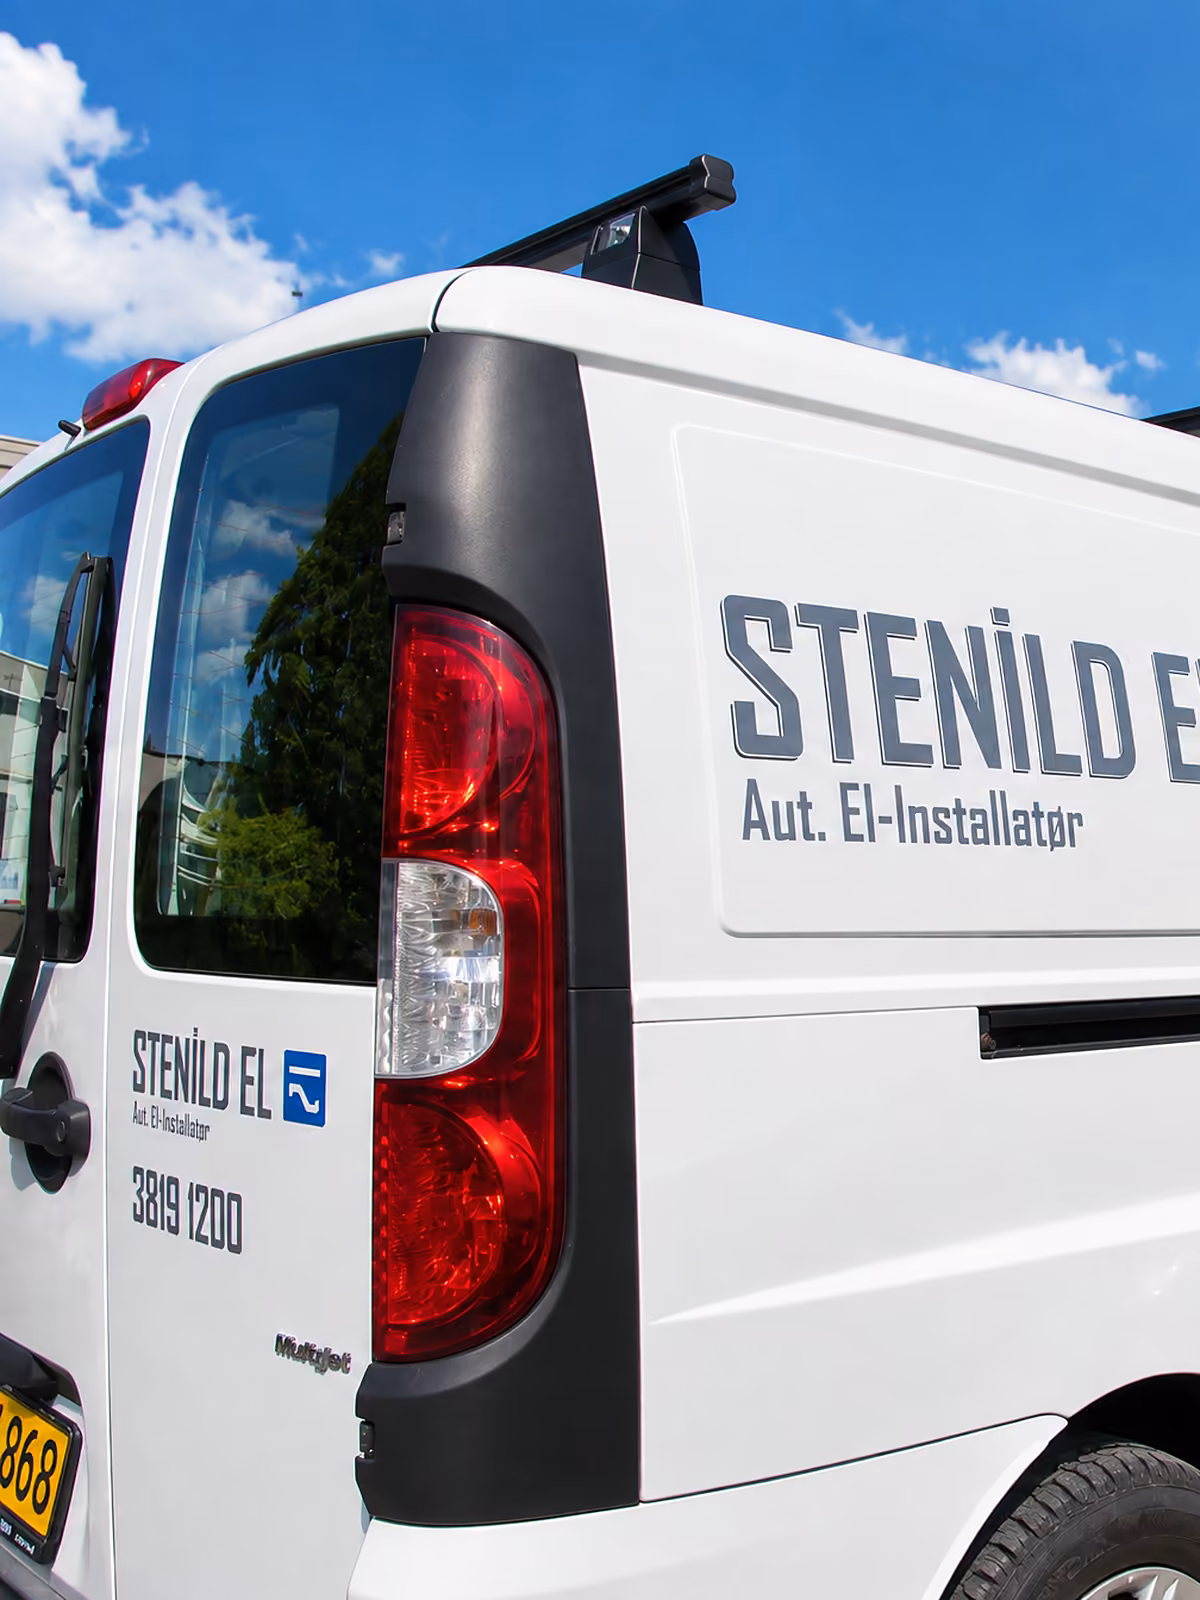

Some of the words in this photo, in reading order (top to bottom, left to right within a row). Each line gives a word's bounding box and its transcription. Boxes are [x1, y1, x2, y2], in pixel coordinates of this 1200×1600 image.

[742, 778, 826, 842] Aut.
[839, 781, 1083, 851] El-Installatør
[132, 1100, 149, 1126] Aut.
[240, 1045, 272, 1120] EL
[133, 1166, 180, 1236] 3819
[188, 1181, 243, 1255] 1200
[0, 1404, 57, 1515] 868
